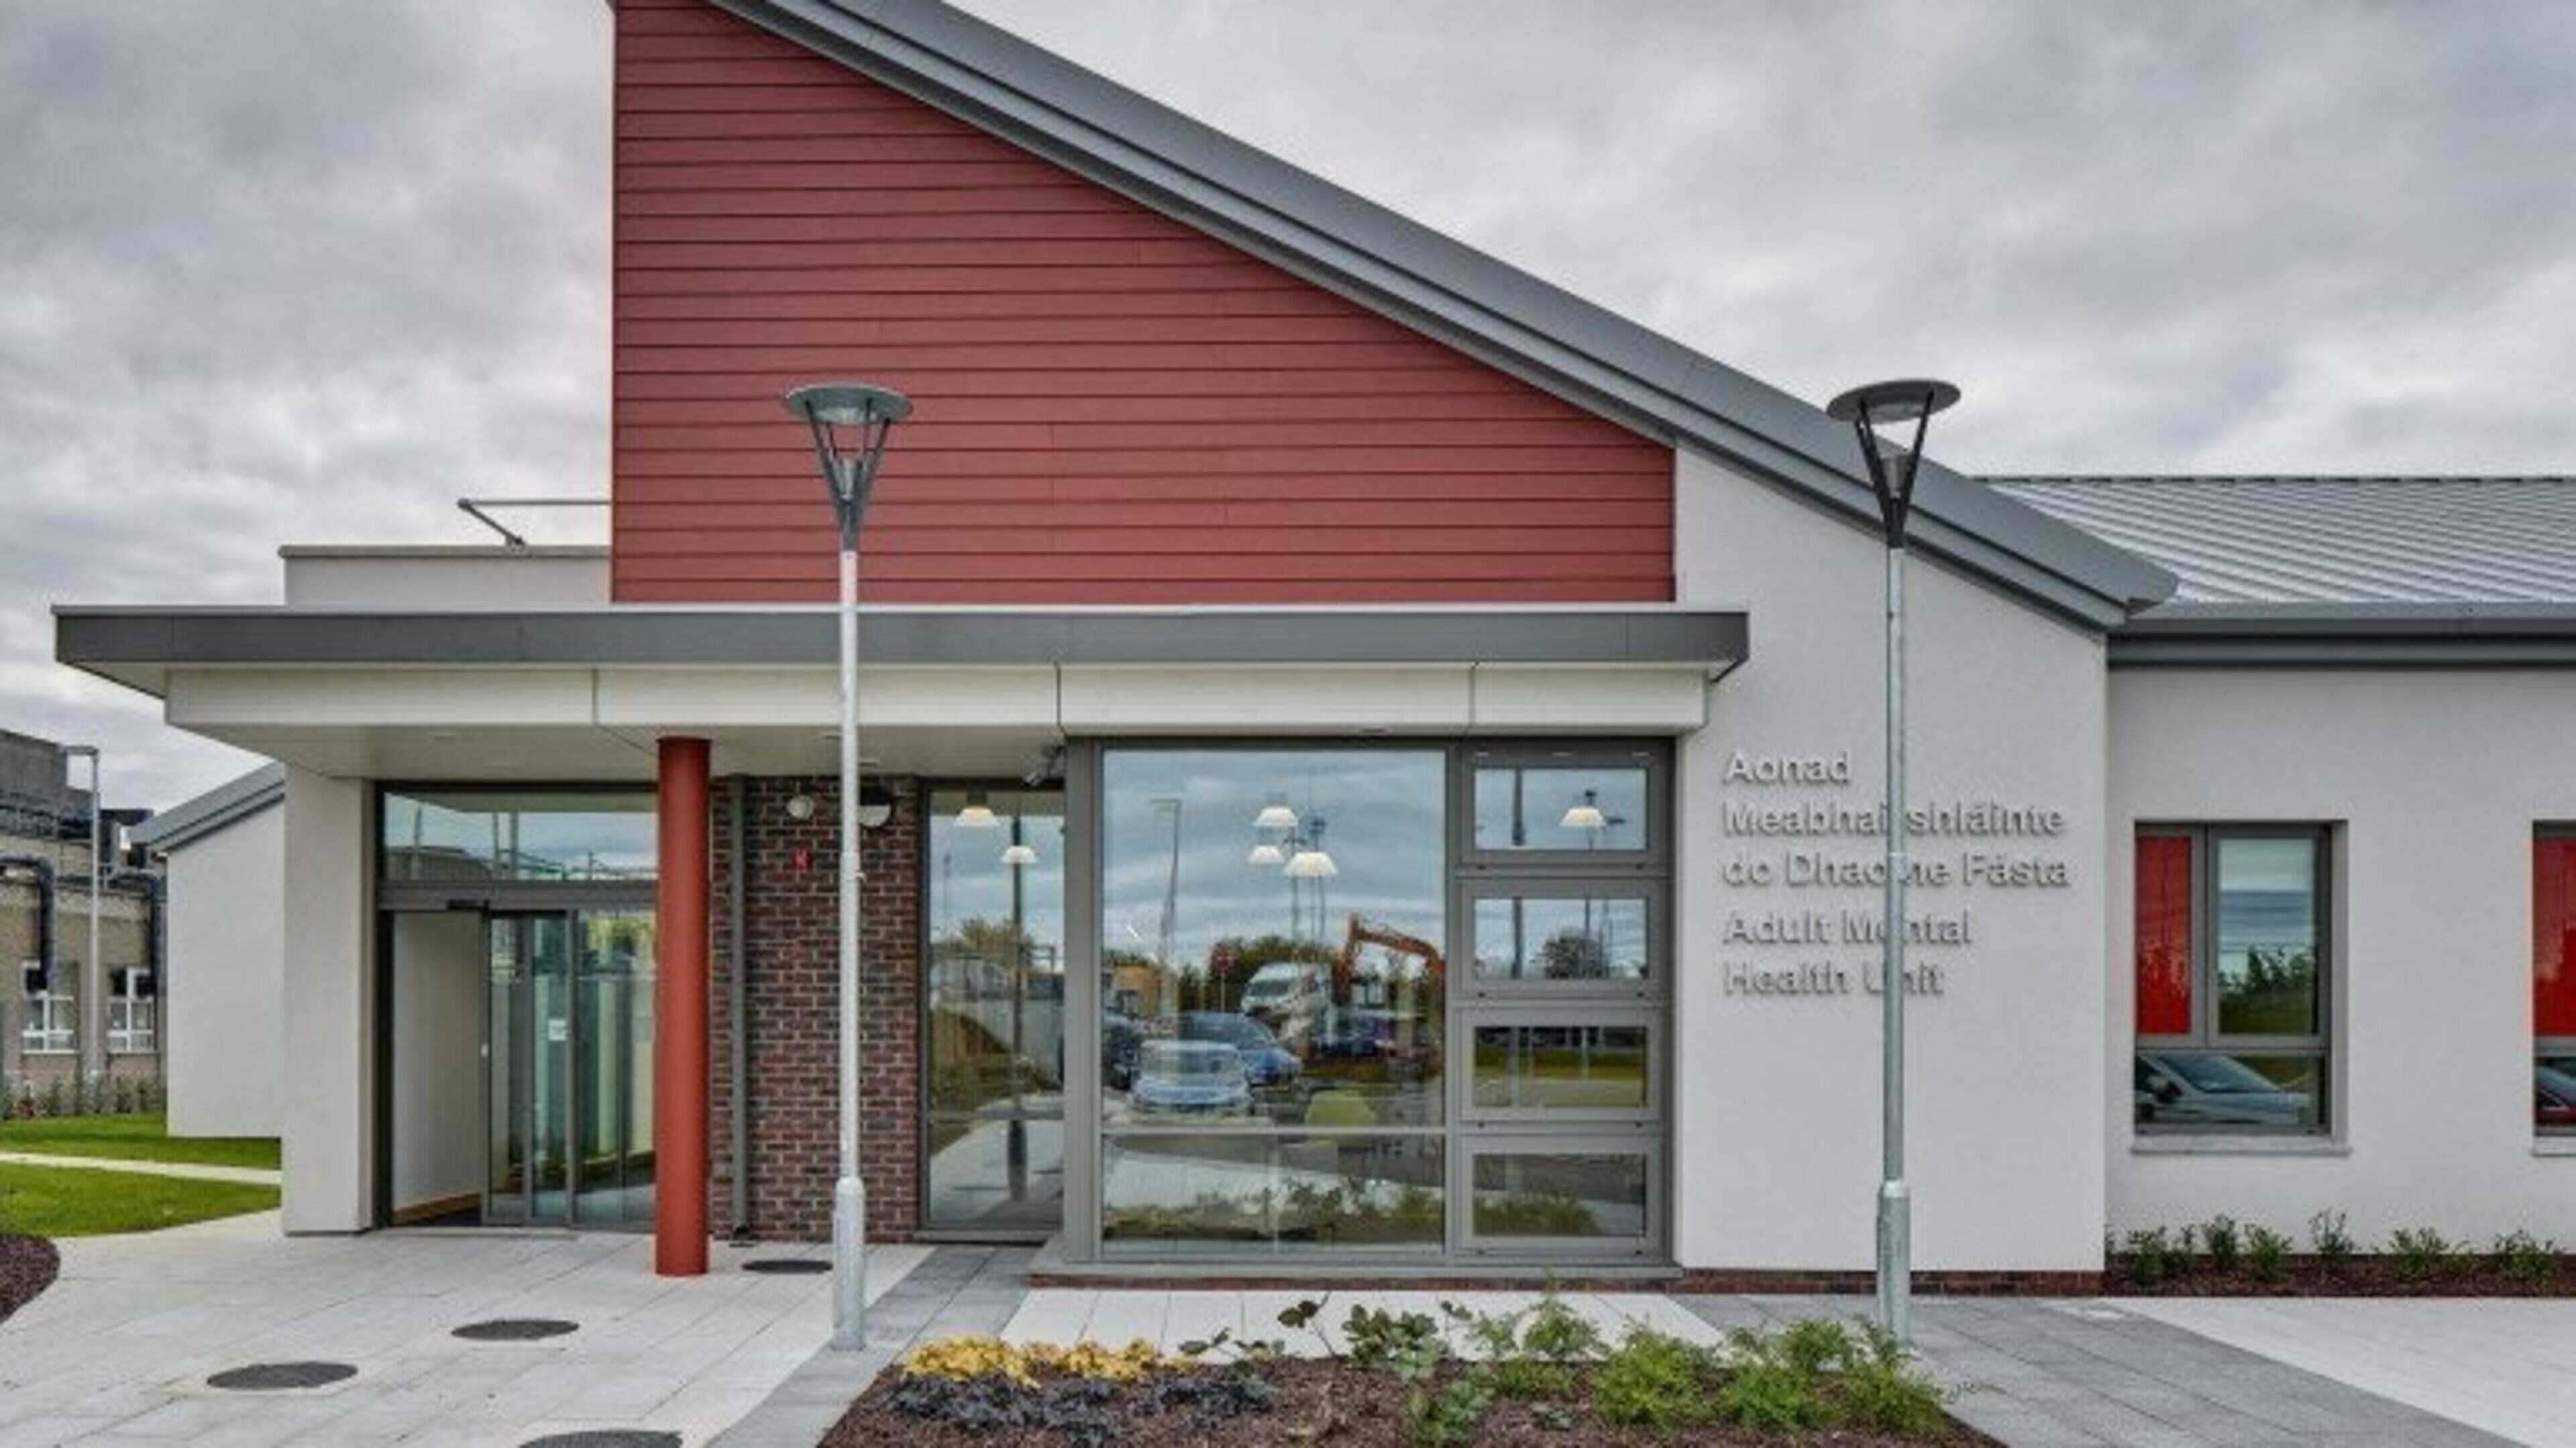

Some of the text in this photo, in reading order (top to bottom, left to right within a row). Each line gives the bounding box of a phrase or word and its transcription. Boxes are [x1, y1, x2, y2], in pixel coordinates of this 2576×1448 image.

[1723, 749, 1851, 785] Aonad
[1722, 801, 2064, 836] Meabhaishláinte
[1722, 850, 2070, 887] do Dhaone Fásta
[1723, 908, 1830, 945] Adult
[1724, 959, 1851, 995] Health
